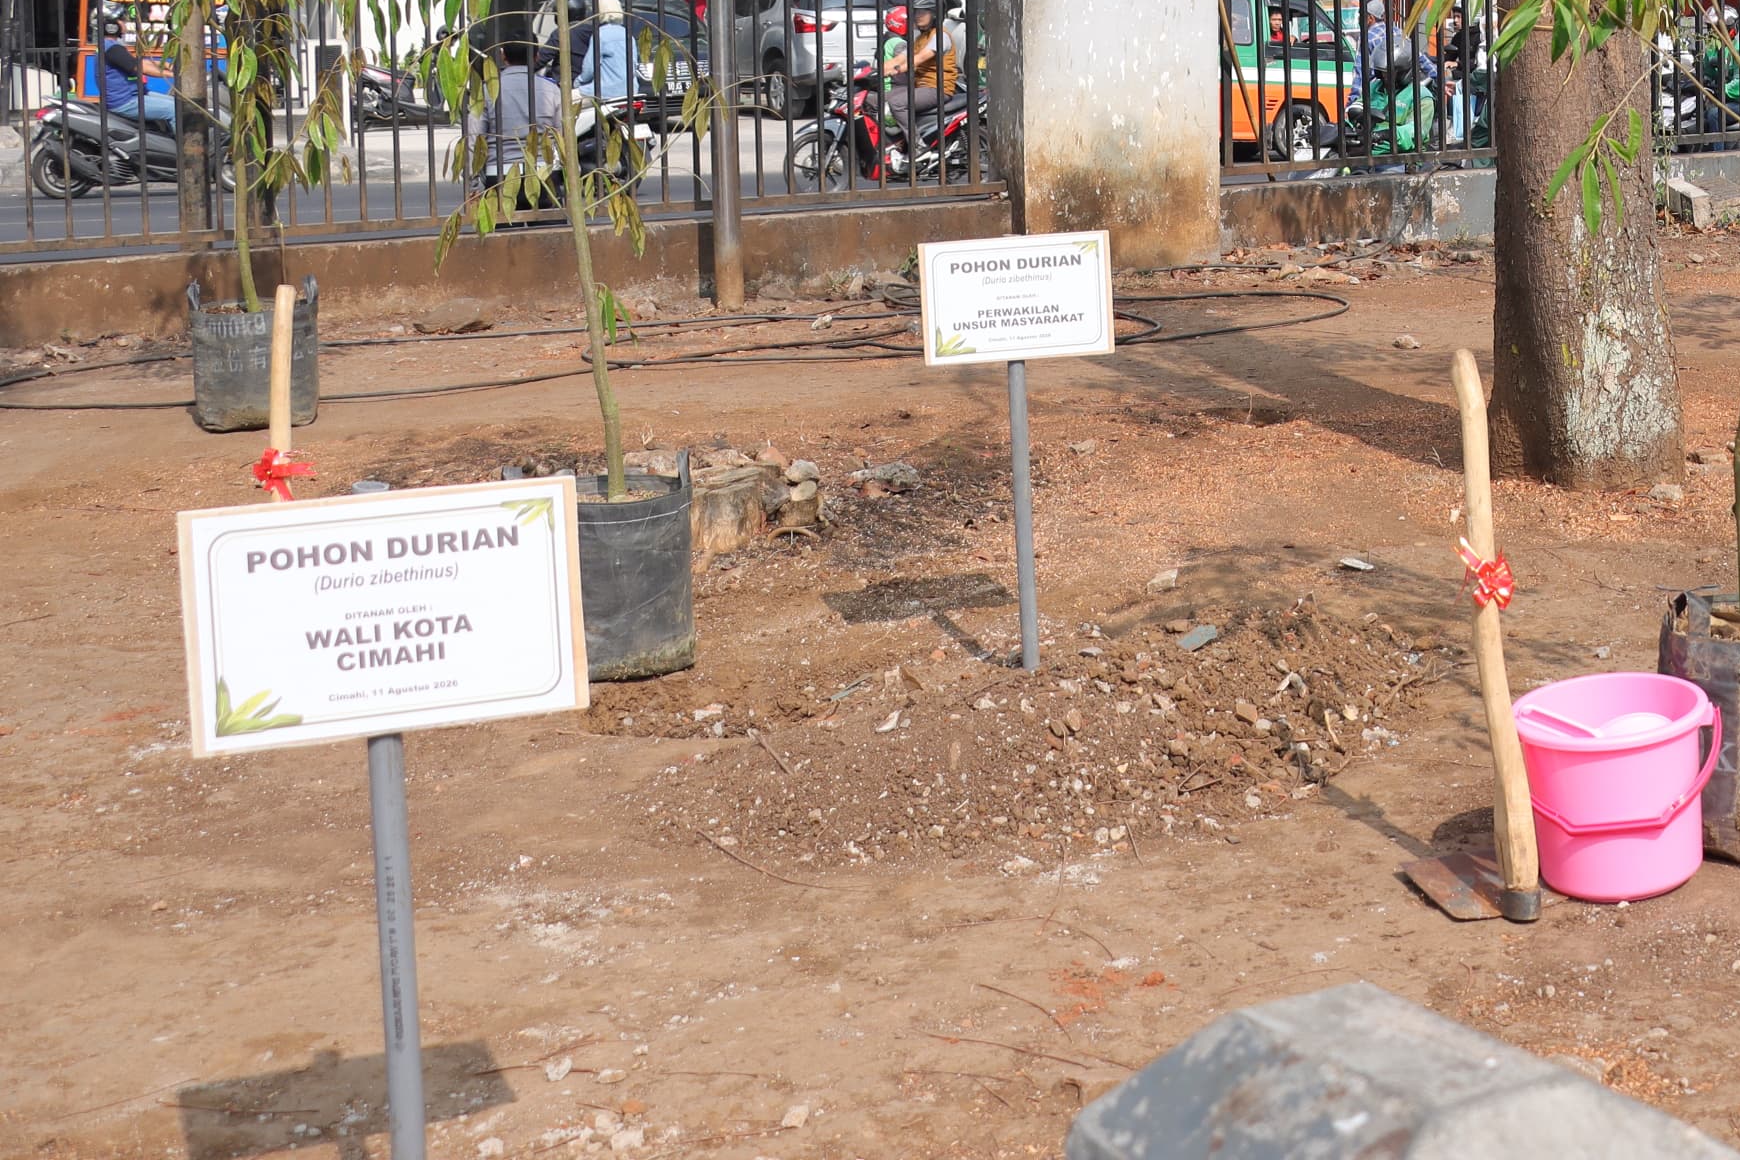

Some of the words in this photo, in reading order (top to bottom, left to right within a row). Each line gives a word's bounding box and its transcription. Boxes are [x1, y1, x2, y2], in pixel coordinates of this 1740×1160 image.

[950, 259, 1011, 275] POHON
[1016, 254, 1082, 270] DURIAN
[952, 317, 997, 331] UNSUR
[1000, 312, 1085, 328] MASYARAKAT
[977, 304, 1060, 319] PERWAKILAN
[246, 539, 374, 574] POHON
[386, 524, 520, 560] DURIAN
[314, 573, 365, 595] (Durio
[369, 562, 459, 586] zibethinus)
[344, 607, 395, 621] DITANAM
[304, 623, 382, 650] WALI
[393, 613, 473, 644] KOTA
[336, 641, 446, 672] CIMAHI
[387, 682, 431, 697] Agustus
